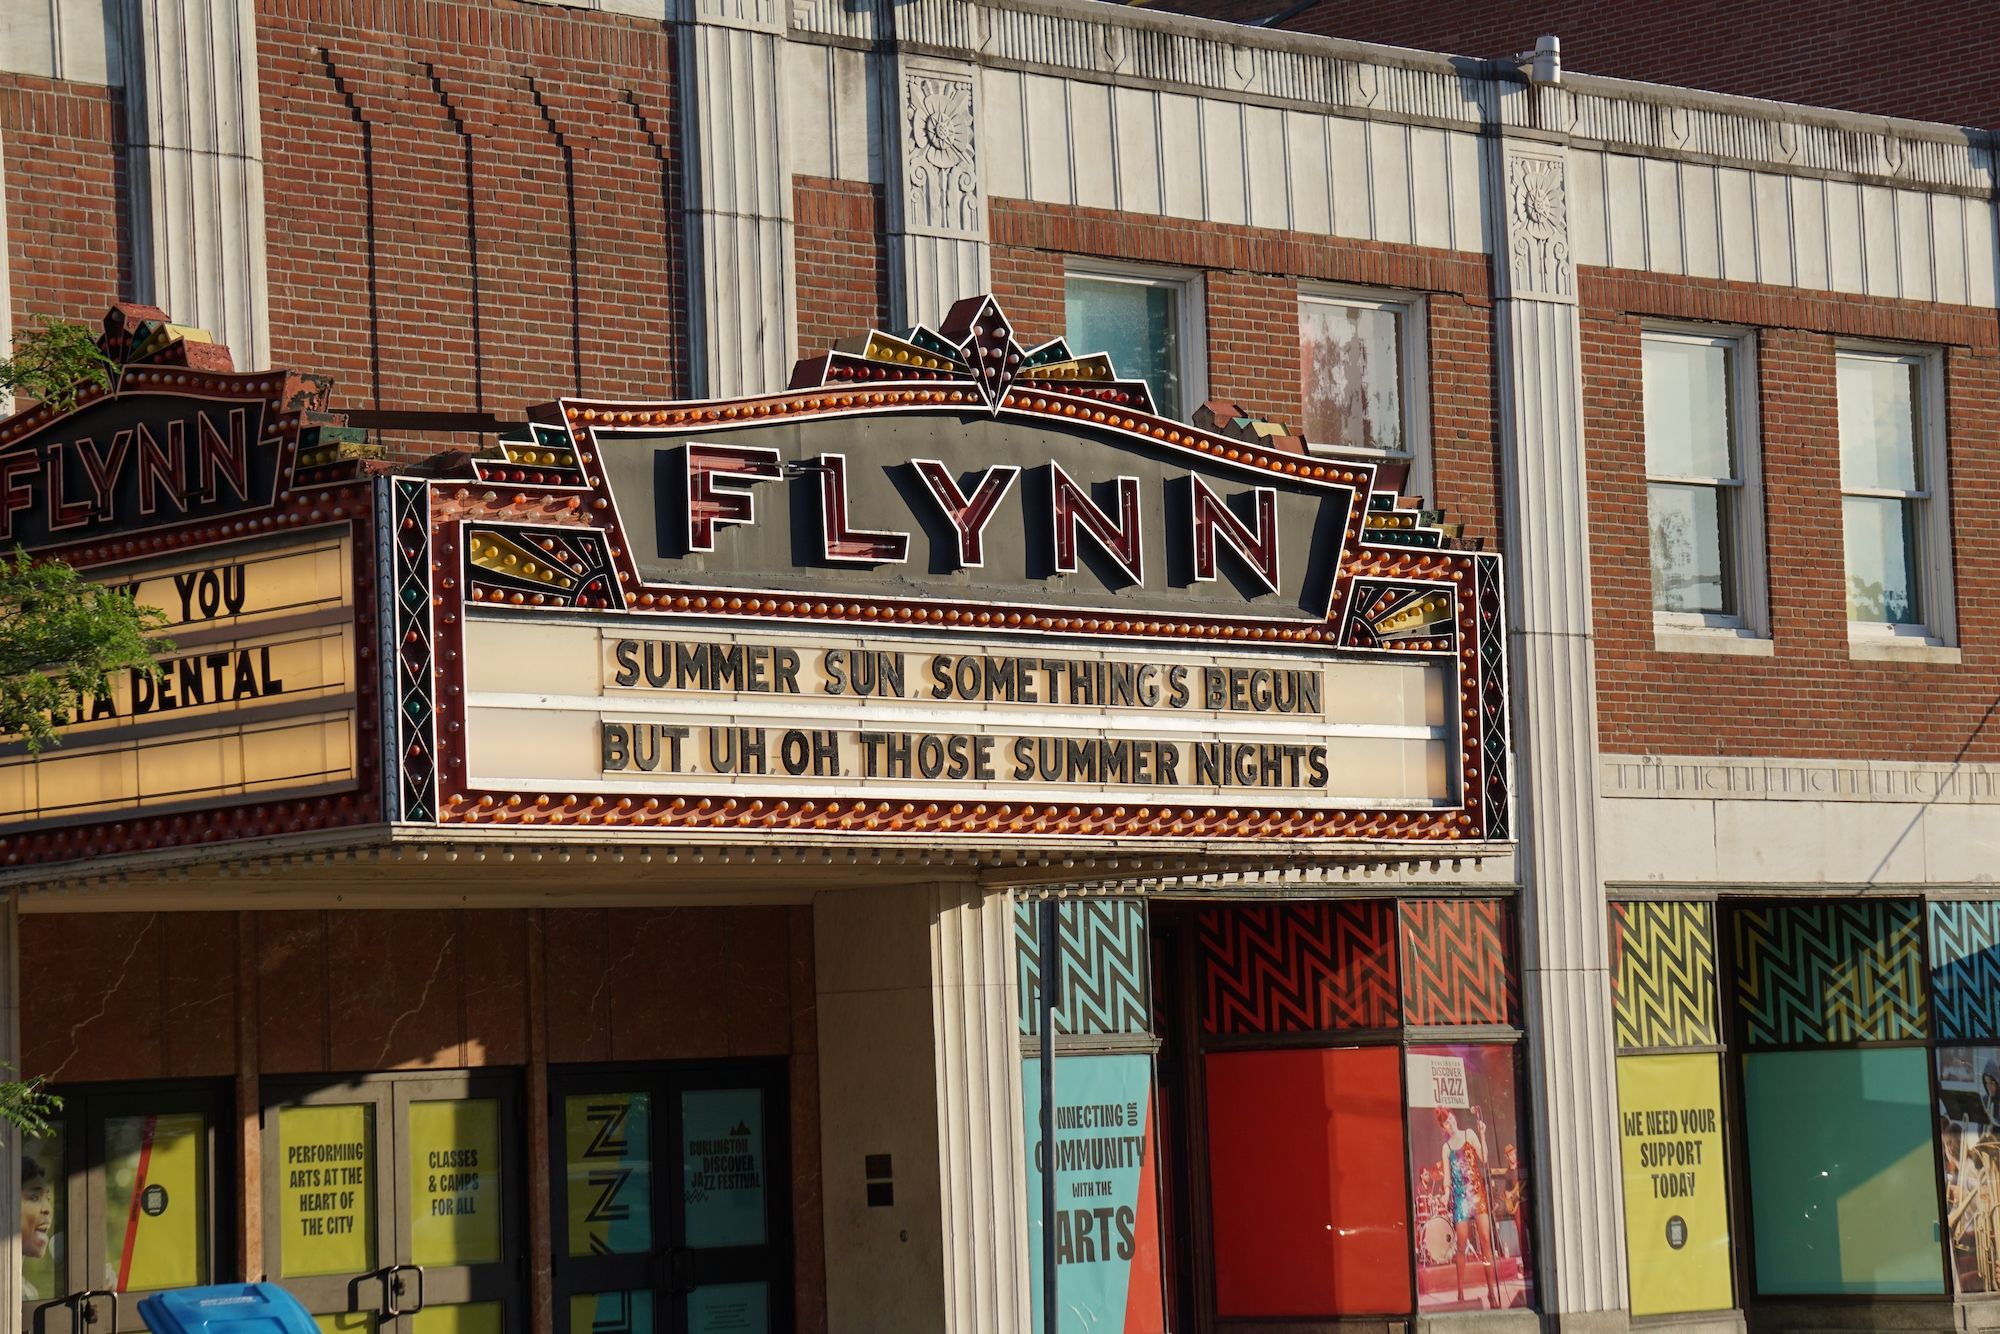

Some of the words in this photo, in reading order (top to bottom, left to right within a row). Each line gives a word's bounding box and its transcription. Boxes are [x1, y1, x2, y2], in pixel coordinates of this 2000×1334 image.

[0, 408, 248, 540] FLYNN
[684, 442, 1281, 596] FLYNN
[174, 564, 245, 622] YOU
[131, 647, 282, 714] DENTAL
[615, 638, 801, 694] SUMMER
[931, 654, 1190, 709] SOMETHING'S
[1205, 666, 1321, 714] BEGUN
[860, 731, 995, 781] THOSE
[1014, 736, 1180, 785] SUMMER
[1196, 742, 1329, 788] NIGHTS
[1431, 1067, 1462, 1077] DISCOVER
[1433, 1077, 1464, 1104] JAZZ
[1039, 1104, 1124, 1130] NNECTING
[1127, 1102, 1138, 1127] OUR
[1623, 1112, 1643, 1136] WE
[1646, 1110, 1678, 1136] NEED
[1680, 1108, 1716, 1134] YOUR
[288, 1142, 363, 1164] PERFORMING
[428, 1149, 478, 1169] CLASSES
[703, 1155, 755, 1173] DISCOVER
[1640, 1140, 1702, 1168] SUPPORT
[290, 1169, 321, 1188] ARTS
[324, 1168, 338, 1186] AT
[341, 1167, 363, 1185] THE
[428, 1174, 437, 1193] &
[440, 1172, 479, 1192] CAMPS
[691, 1173, 716, 1191] JAZZ
[718, 1172, 762, 1191] FESTIVAL
[1072, 1182, 1094, 1198] WITH
[1095, 1180, 1112, 1196] THE
[1651, 1172, 1695, 1199] TODAY
[300, 1192, 337, 1212] HEART
[340, 1191, 354, 1210] OF
[432, 1198, 453, 1216] FOR
[456, 1196, 476, 1215] ALL
[301, 1217, 323, 1236] THE
[327, 1215, 353, 1234] CITY
[1056, 1205, 1136, 1265] ARTS
